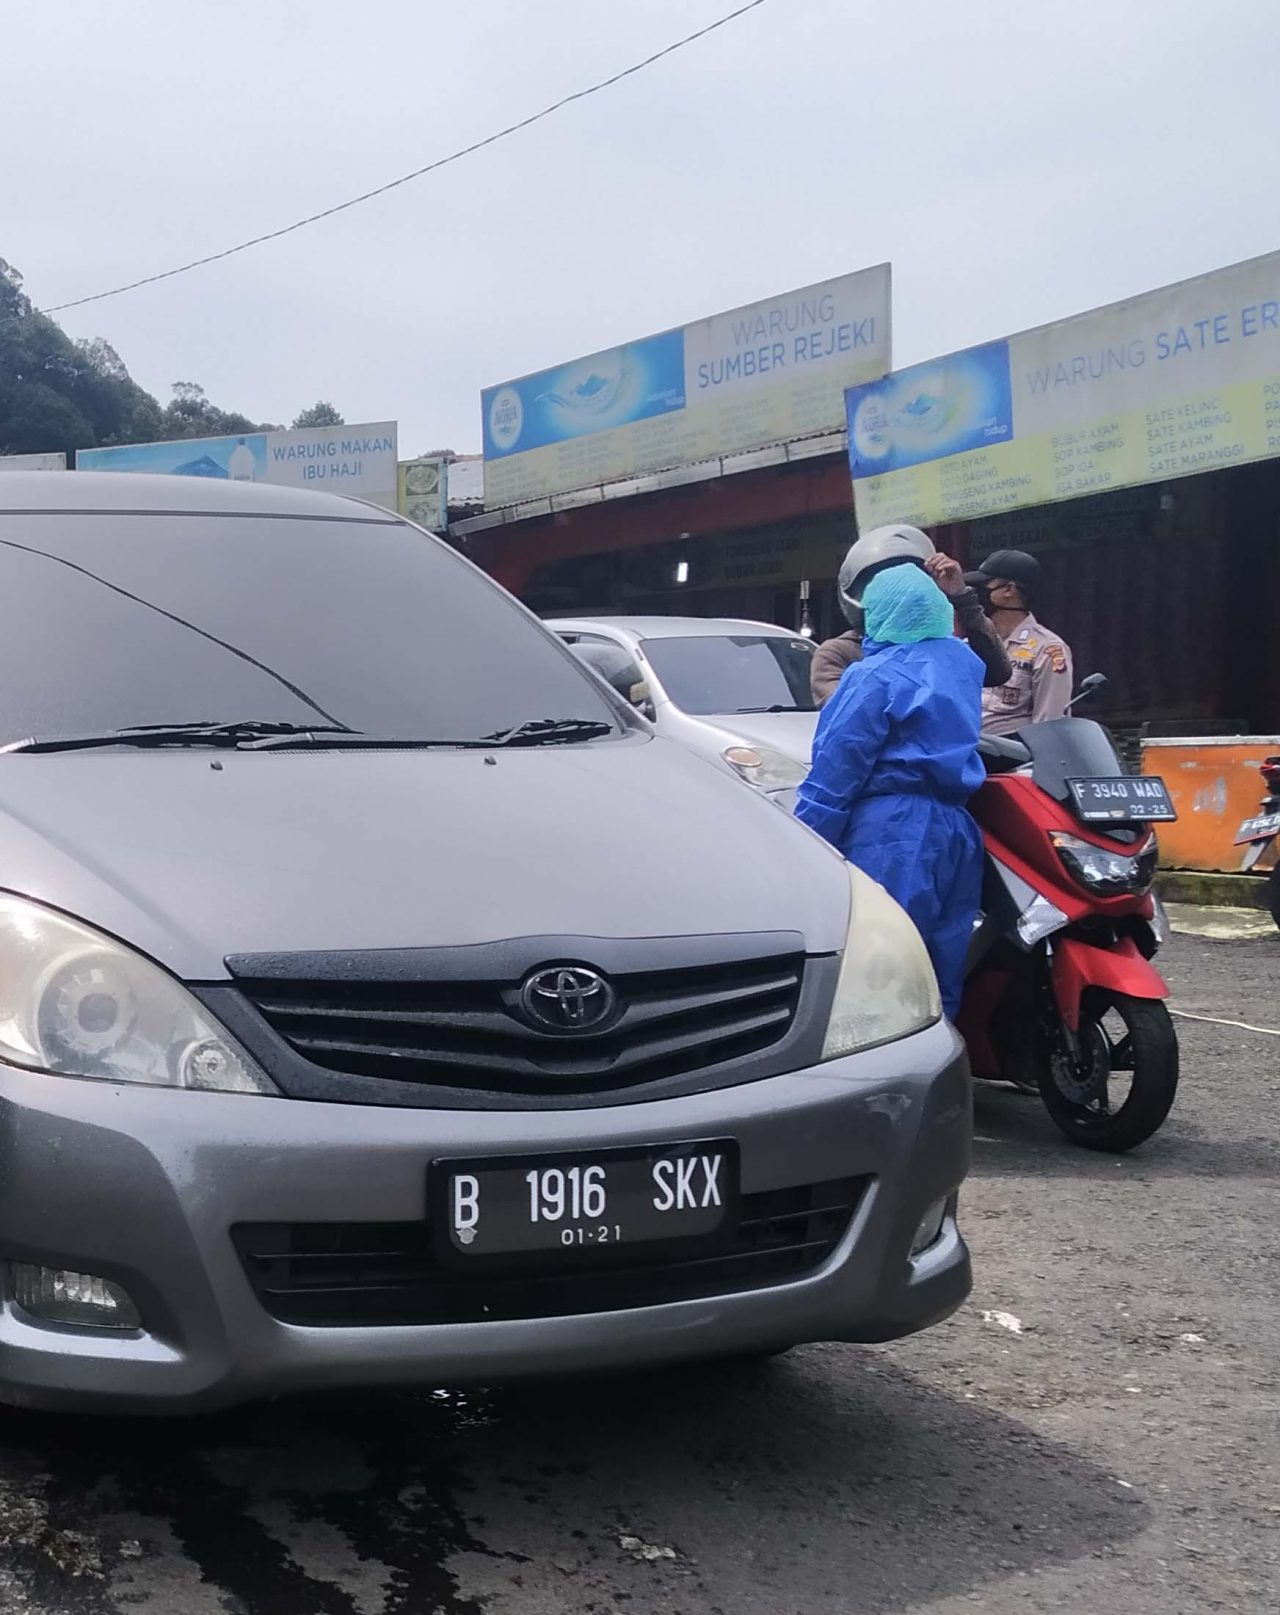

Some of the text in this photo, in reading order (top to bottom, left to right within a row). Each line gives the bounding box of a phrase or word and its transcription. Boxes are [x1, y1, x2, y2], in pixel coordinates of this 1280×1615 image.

[732, 294, 835, 346] WARUNG
[698, 317, 875, 389] SUMBER REJEKI
[1026, 340, 1146, 395] WARUNG
[1155, 314, 1231, 361] SATE
[1145, 408, 1175, 426] SATE
[1146, 424, 1176, 441] SATE
[273, 437, 394, 461] WARUNG MAKAN
[1148, 441, 1177, 458] SATE
[303, 462, 362, 480] IBU HAJI
[1150, 457, 1178, 474] SATE
[1075, 782, 1163, 798] F 3940 WAD
[454, 1154, 723, 1229] B 1916 SKX
